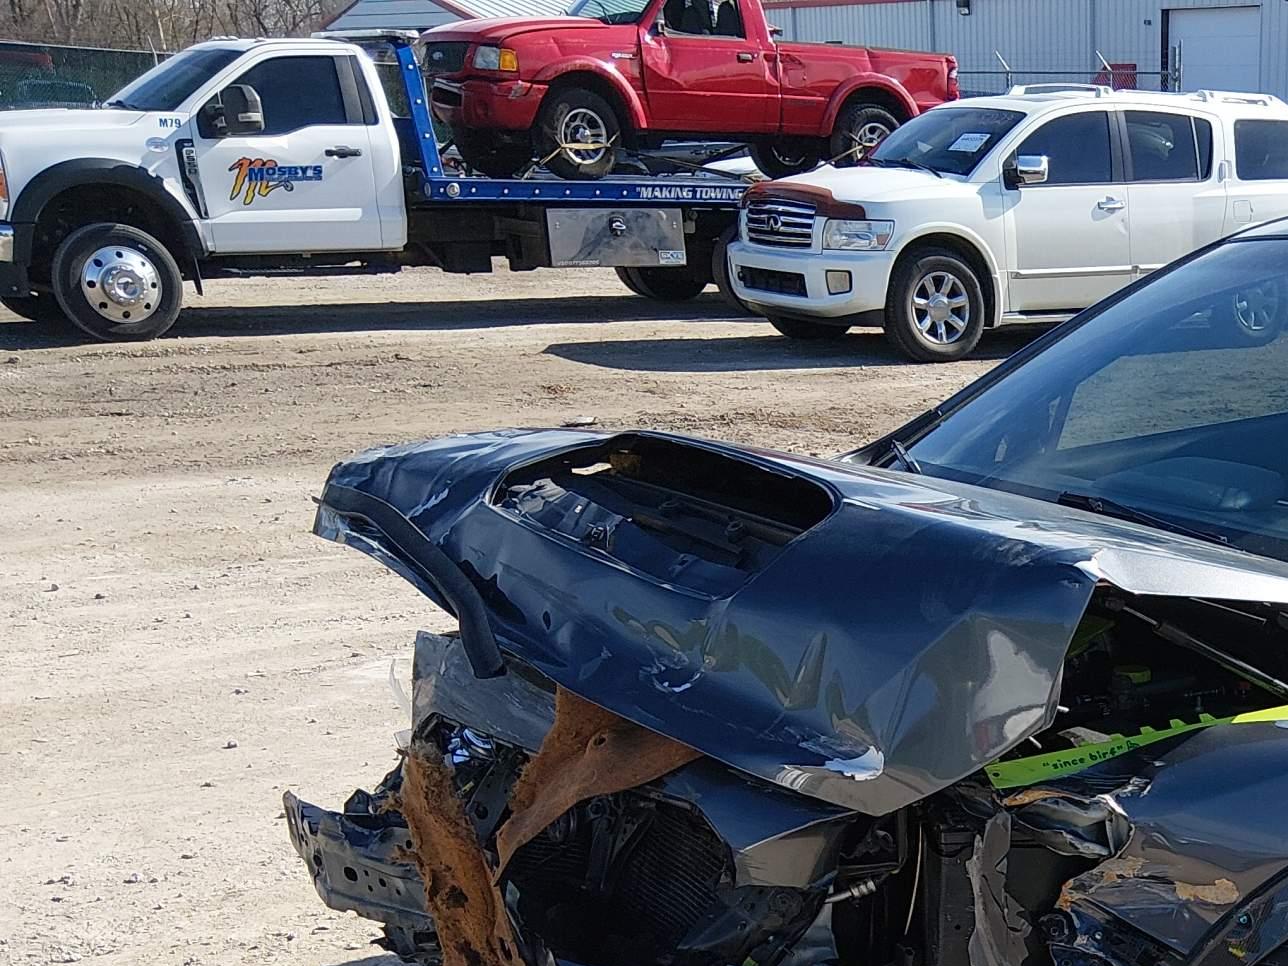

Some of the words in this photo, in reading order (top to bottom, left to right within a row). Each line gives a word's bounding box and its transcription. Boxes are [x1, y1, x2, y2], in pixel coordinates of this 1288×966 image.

[159, 118, 182, 128] M79
[248, 165, 323, 181] MOSBY'S
[695, 187, 745, 199] TOWING
